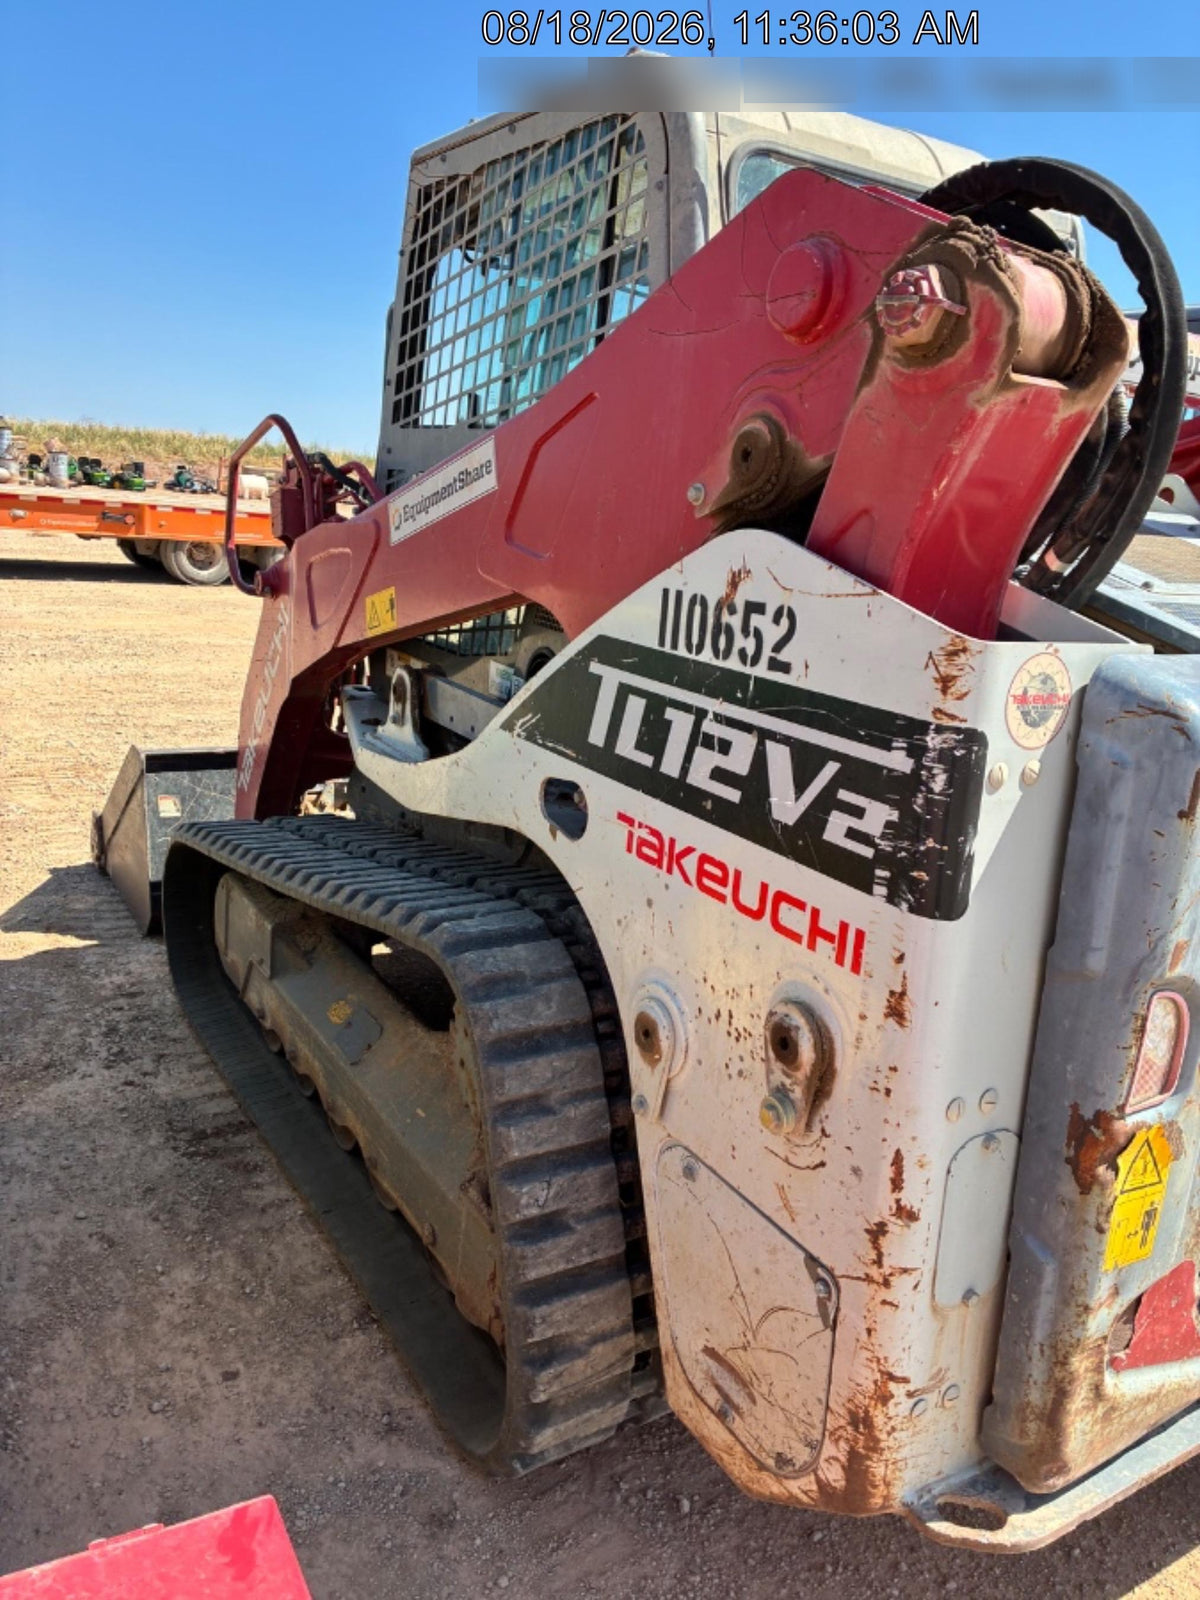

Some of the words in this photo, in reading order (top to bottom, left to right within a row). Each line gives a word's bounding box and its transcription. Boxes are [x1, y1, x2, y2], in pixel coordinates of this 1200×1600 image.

[401, 457, 493, 525] EquipmentShare
[656, 587, 798, 675] 110652
[587, 660, 915, 860] TL12V2
[616, 811, 867, 976] TAKEUCHI
